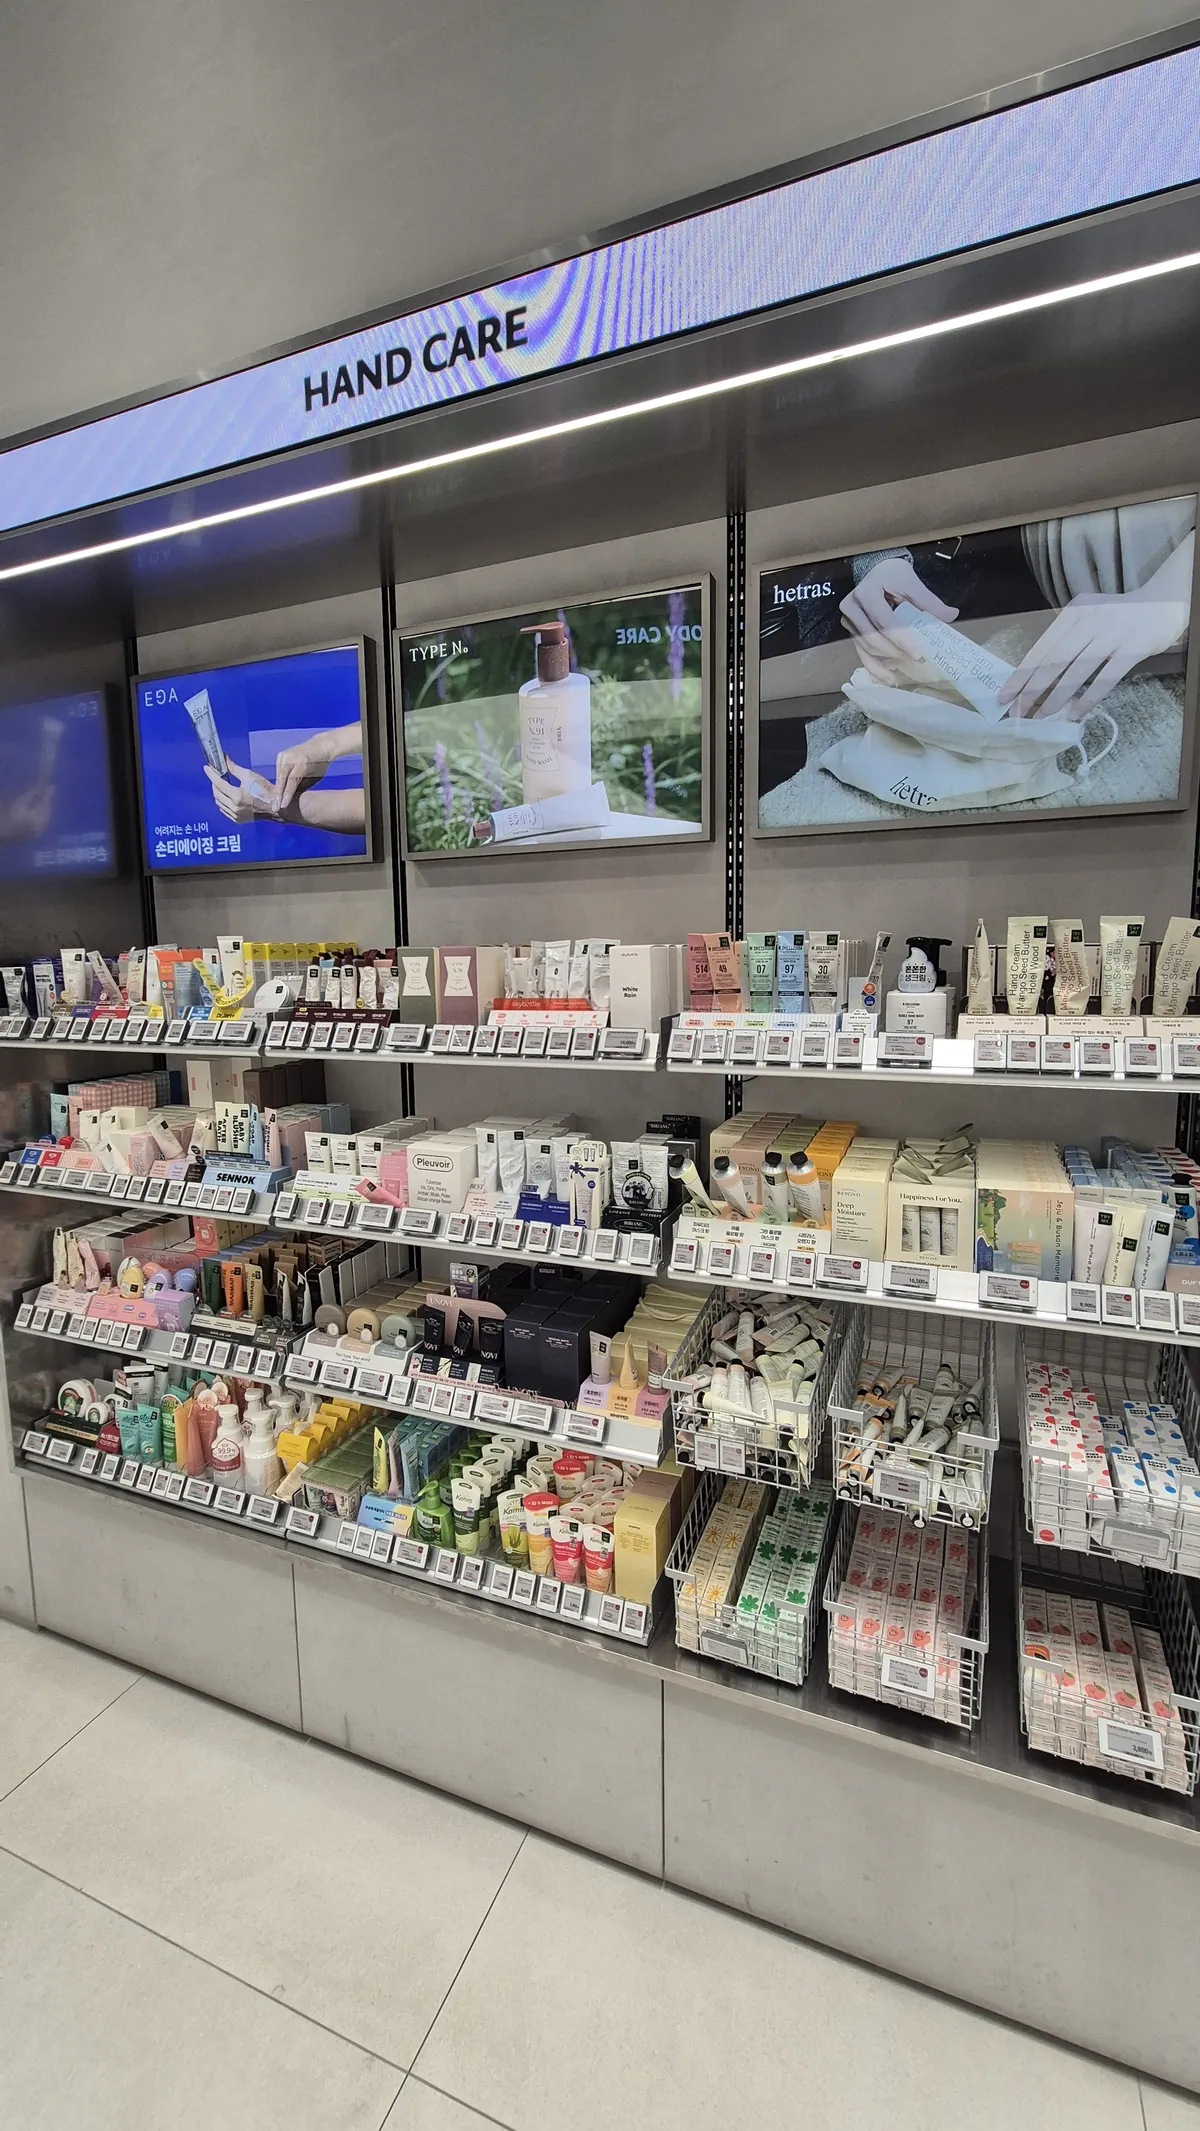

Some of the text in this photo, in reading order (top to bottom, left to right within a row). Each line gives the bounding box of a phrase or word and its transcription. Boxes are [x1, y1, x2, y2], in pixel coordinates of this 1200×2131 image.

[304, 307, 529, 412] HAND CARE
[773, 580, 836, 605] hetras.
[410, 644, 447, 662] TYPE
[914, 620, 1001, 692] Mango Seed Butter
[936, 623, 994, 671] Hand Cream
[934, 652, 964, 681] Hinoki
[155, 822, 209, 836] 어려지는 손 나이
[216, 834, 241, 853] 크림
[1114, 930, 1124, 955] Butter
[696, 964, 709, 974] 514
[719, 965, 728, 973] 49
[757, 965, 766, 974] 07
[785, 964, 795, 974] 97
[818, 965, 828, 975] 30
[1010, 944, 1021, 996] Hand Cream
[1016, 931, 1031, 1010] Mango Seed Butter
[1028, 946, 1039, 994] Hotel Wood
[1056, 947, 1067, 997] Hand Cream
[1104, 943, 1114, 997] Hand Cream
[1113, 956, 1121, 980] Seed
[1122, 949, 1133, 991] Hug Soap
[1160, 943, 1178, 997] Hand Cream
[1168, 931, 1193, 1015] Mango Seed Butter
[1180, 961, 1193, 981] Artist
[417, 1158, 451, 1169] Pleuvoir
[216, 1173, 256, 1185] SENNOK
[900, 1193, 935, 1201] Happiness
[837, 1209, 867, 1217] Moisture
[1054, 1250, 1062, 1282] Memorie
[481, 1350, 499, 1360] NOVE
